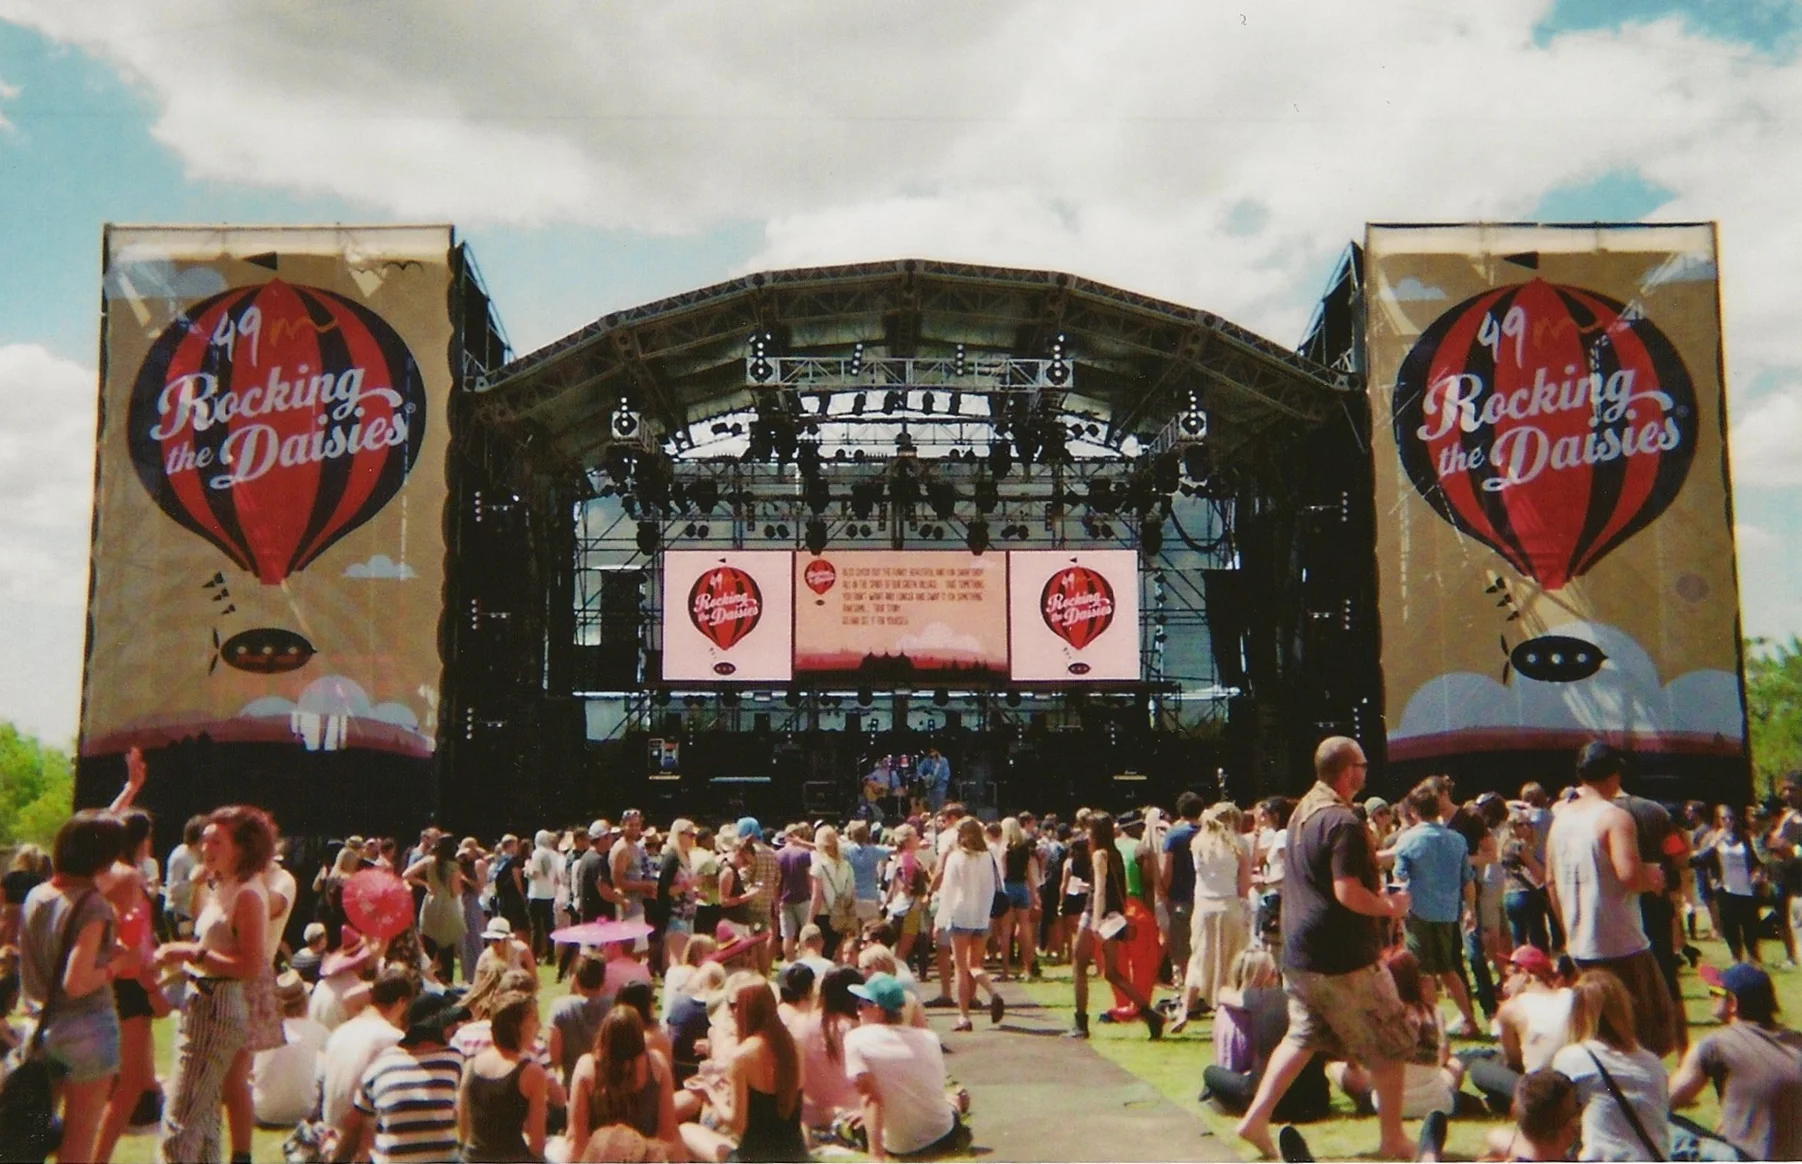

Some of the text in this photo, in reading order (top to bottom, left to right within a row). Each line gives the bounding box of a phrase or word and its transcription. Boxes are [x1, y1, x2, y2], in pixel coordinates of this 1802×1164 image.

[150, 364, 404, 441] Rocking
[1416, 364, 1675, 441] Rocking
[165, 406, 409, 490] the Daisies
[1438, 409, 1681, 492] the Daisies
[694, 592, 757, 612] Rocking
[1046, 592, 1110, 612] Rocking
